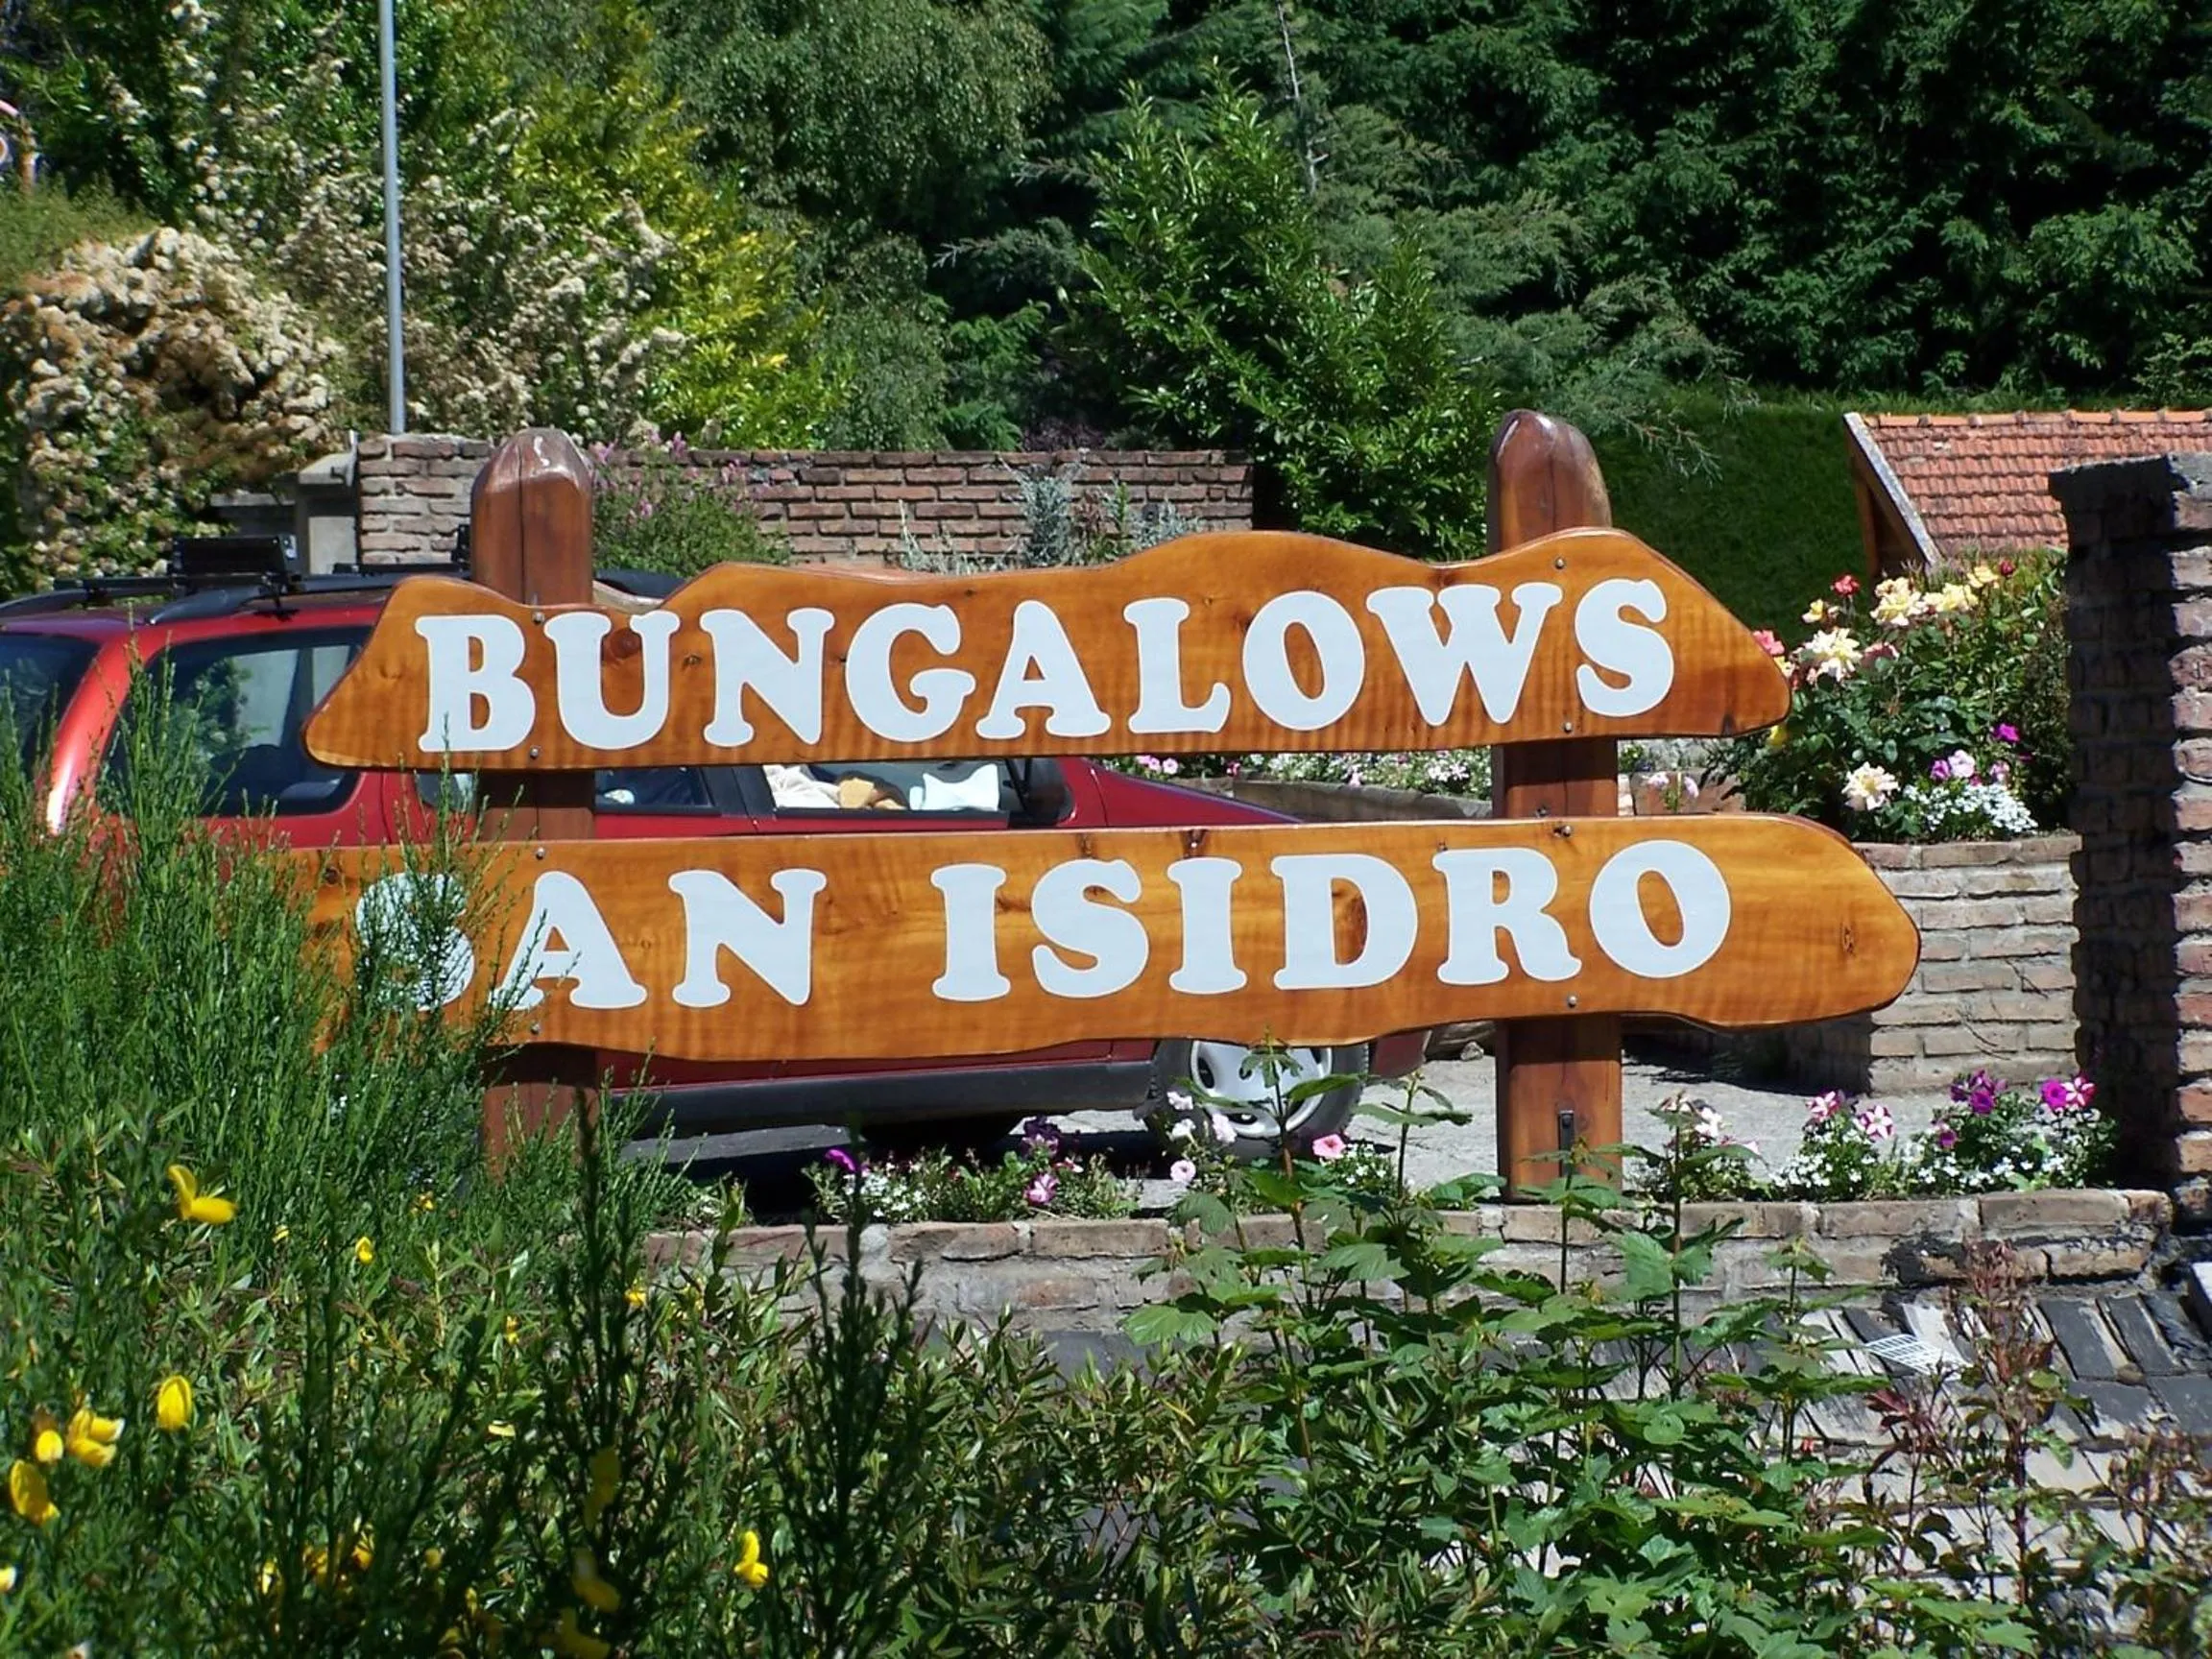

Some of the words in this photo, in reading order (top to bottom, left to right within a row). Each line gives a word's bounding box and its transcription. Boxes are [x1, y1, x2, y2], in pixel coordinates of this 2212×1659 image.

[414, 577, 1676, 753] BUNGALOWS
[353, 869, 828, 1010] SAN
[929, 838, 1732, 1002] ISIDRO
